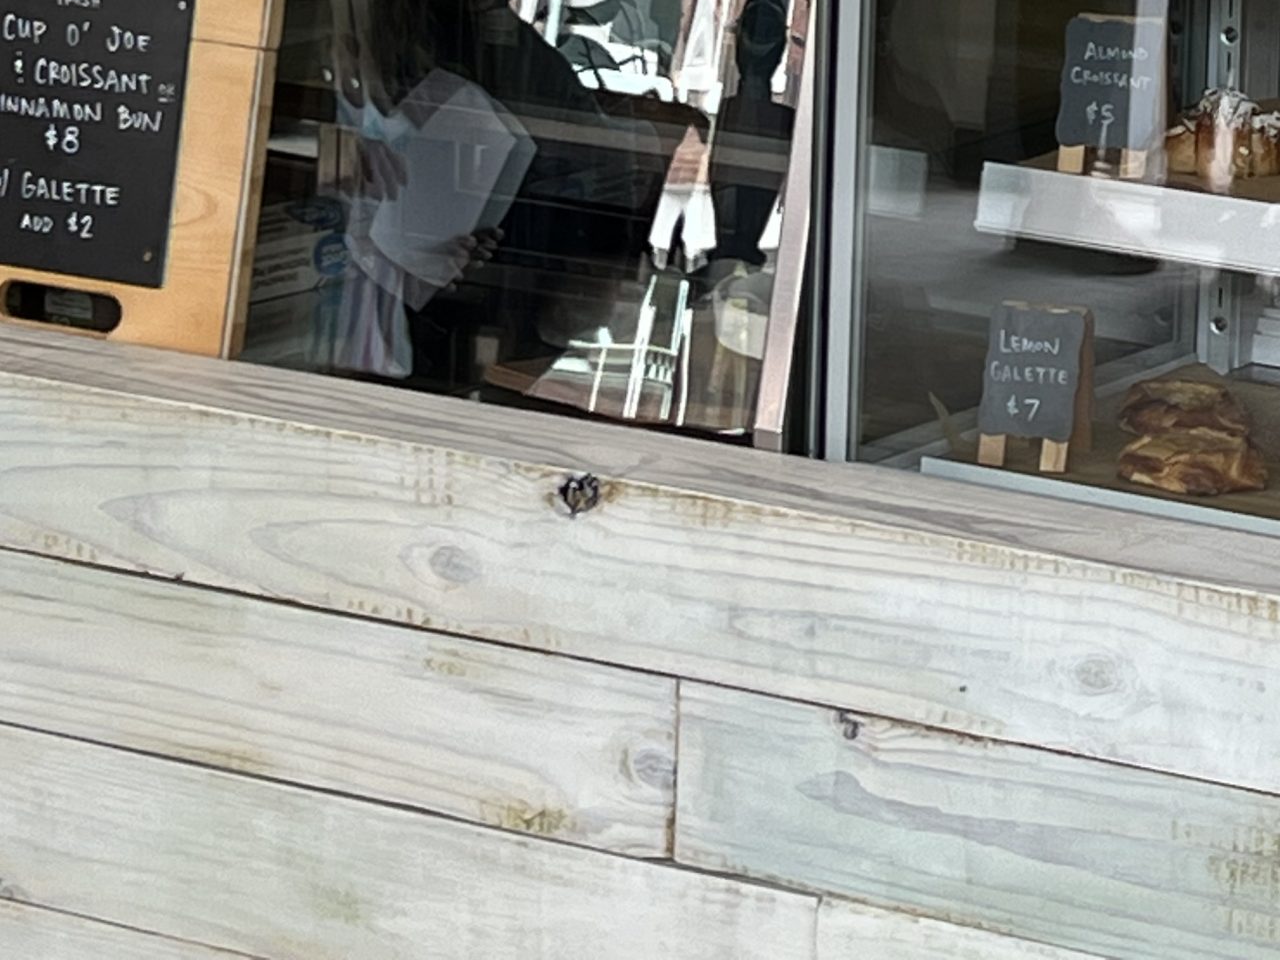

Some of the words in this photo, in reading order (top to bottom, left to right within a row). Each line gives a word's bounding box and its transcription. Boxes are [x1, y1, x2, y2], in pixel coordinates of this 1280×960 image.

[2, 13, 47, 43] CUP
[66, 21, 91, 47] O'
[106, 25, 151, 53] JOE
[1084, 42, 1148, 60] ALMOND
[34, 57, 151, 94] CROISSANT
[1070, 66, 1152, 89] CROISSANT
[117, 105, 162, 132] BUN
[1086, 101, 1114, 124] $5
[45, 123, 79, 153] $8
[21, 171, 120, 205] GALETTE
[20, 213, 53, 233] ADD
[67, 211, 93, 238] $2
[1000, 329, 1060, 355] LEMON
[990, 360, 1068, 385] GALETTE
[1006, 394, 1040, 421] $7
